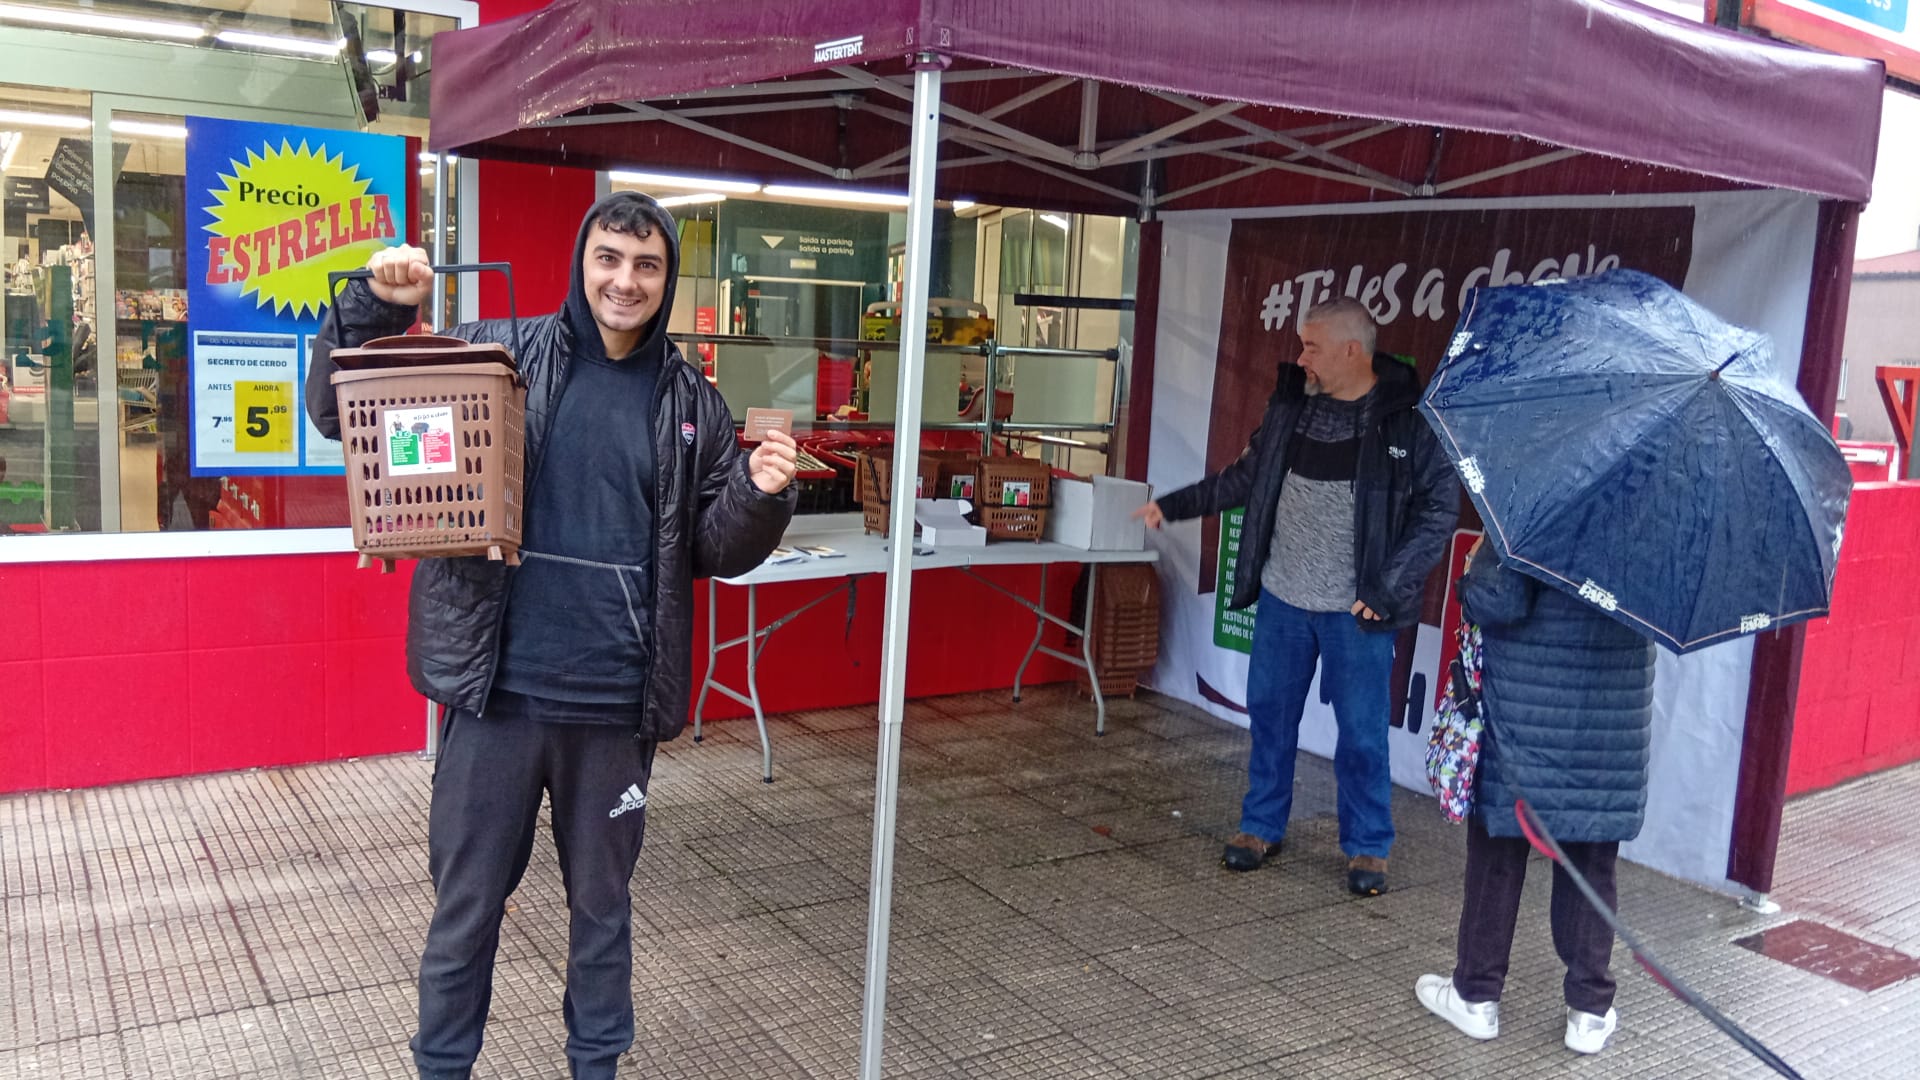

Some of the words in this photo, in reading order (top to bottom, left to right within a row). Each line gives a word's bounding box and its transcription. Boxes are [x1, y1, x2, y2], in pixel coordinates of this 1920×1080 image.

[814, 41, 863, 63] MASTERTENT
[239, 181, 320, 207] Precio
[206, 194, 396, 285] ESTRELLA
[826, 238, 853, 247] parking
[828, 247, 855, 256] parking
[1412, 268, 1445, 321] a
[207, 358, 246, 367] SECRETO
[247, 359, 258, 367] DE
[208, 383, 232, 391] ANTES
